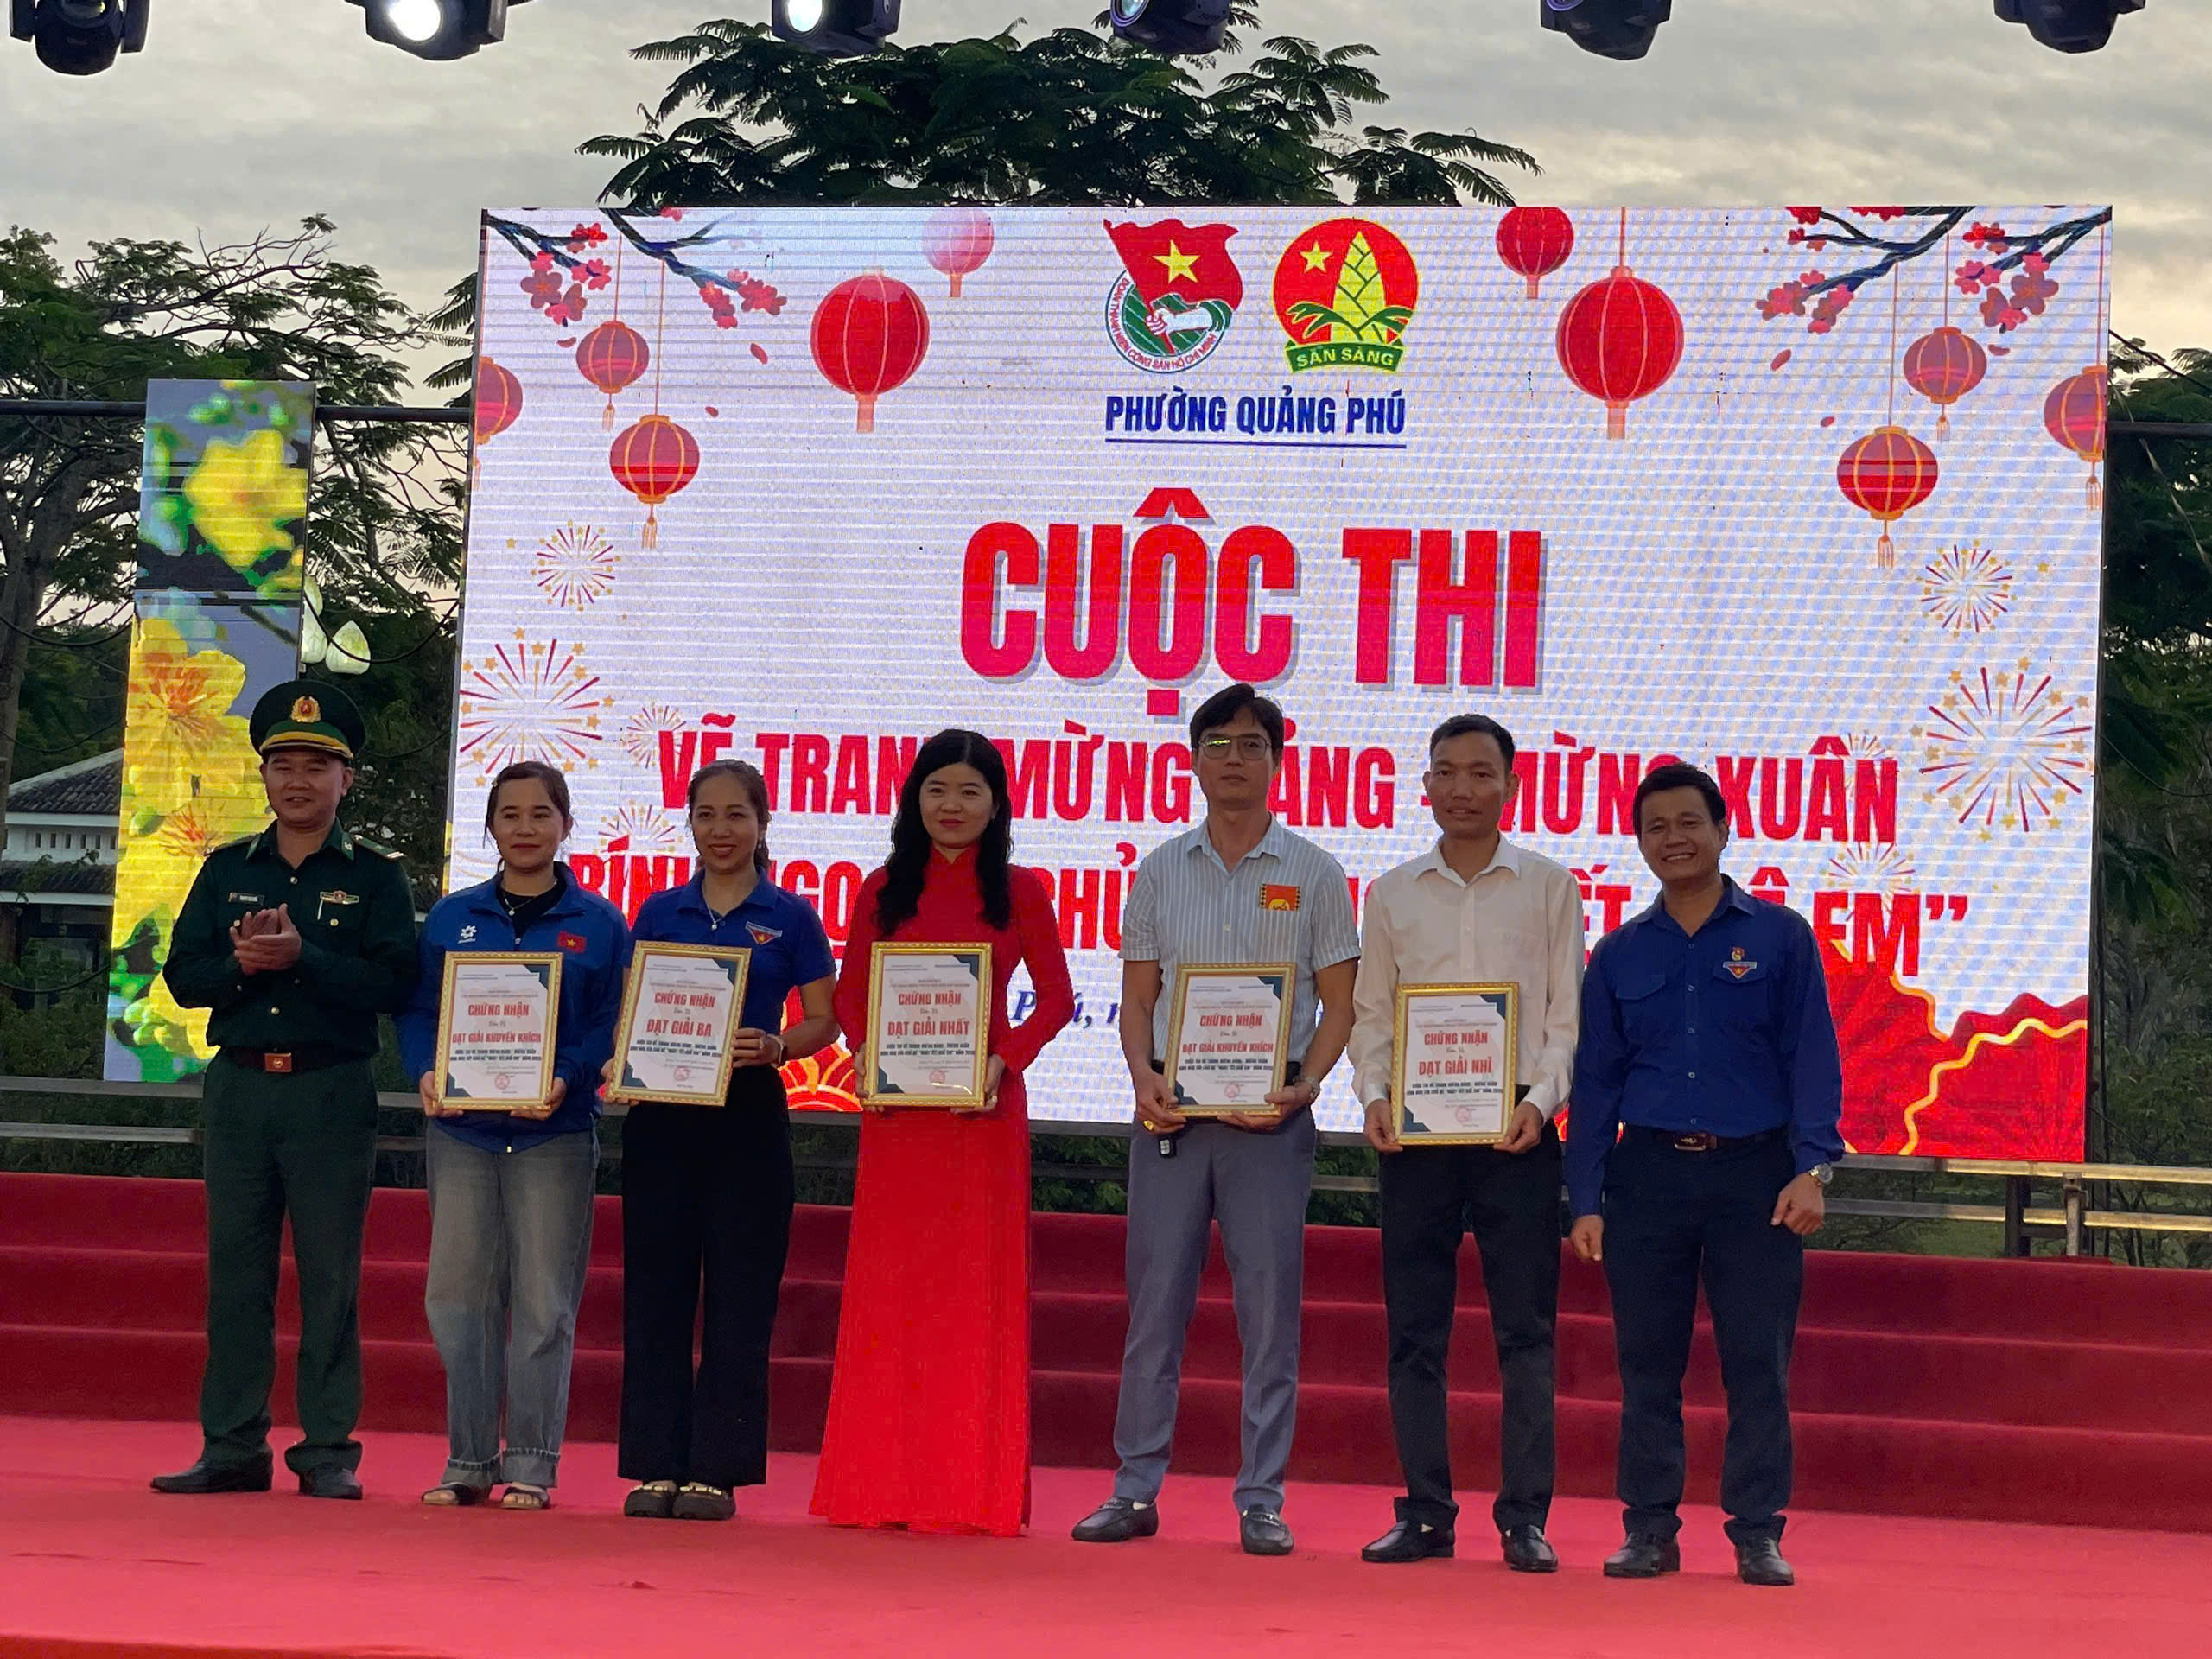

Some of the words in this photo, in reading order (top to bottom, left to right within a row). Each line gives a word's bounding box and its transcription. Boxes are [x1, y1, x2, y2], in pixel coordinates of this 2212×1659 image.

[1106, 385, 1227, 432] PHƯỜNG
[1236, 385, 1337, 435] QUẢNG
[1346, 389, 1406, 434] PHÚ
[961, 487, 1296, 715] CUỘC
[1343, 528, 1543, 688] THI
[755, 733, 931, 816] TRAN
[990, 719, 1192, 823] MỪNG
[1266, 717, 1395, 829] ẢNG
[1497, 730, 1683, 836] MỪN
[1715, 736, 1898, 842] XUÂN
[646, 1019, 669, 1036] ĐẠT
[671, 1017, 694, 1035] GIẢI
[696, 1022, 712, 1037] BA
[887, 1021, 909, 1039] ĐẠT
[912, 1016, 936, 1036] GIẢI
[1419, 1061, 1441, 1078] ĐẠT
[1445, 1055, 1468, 1074] GIẢI
